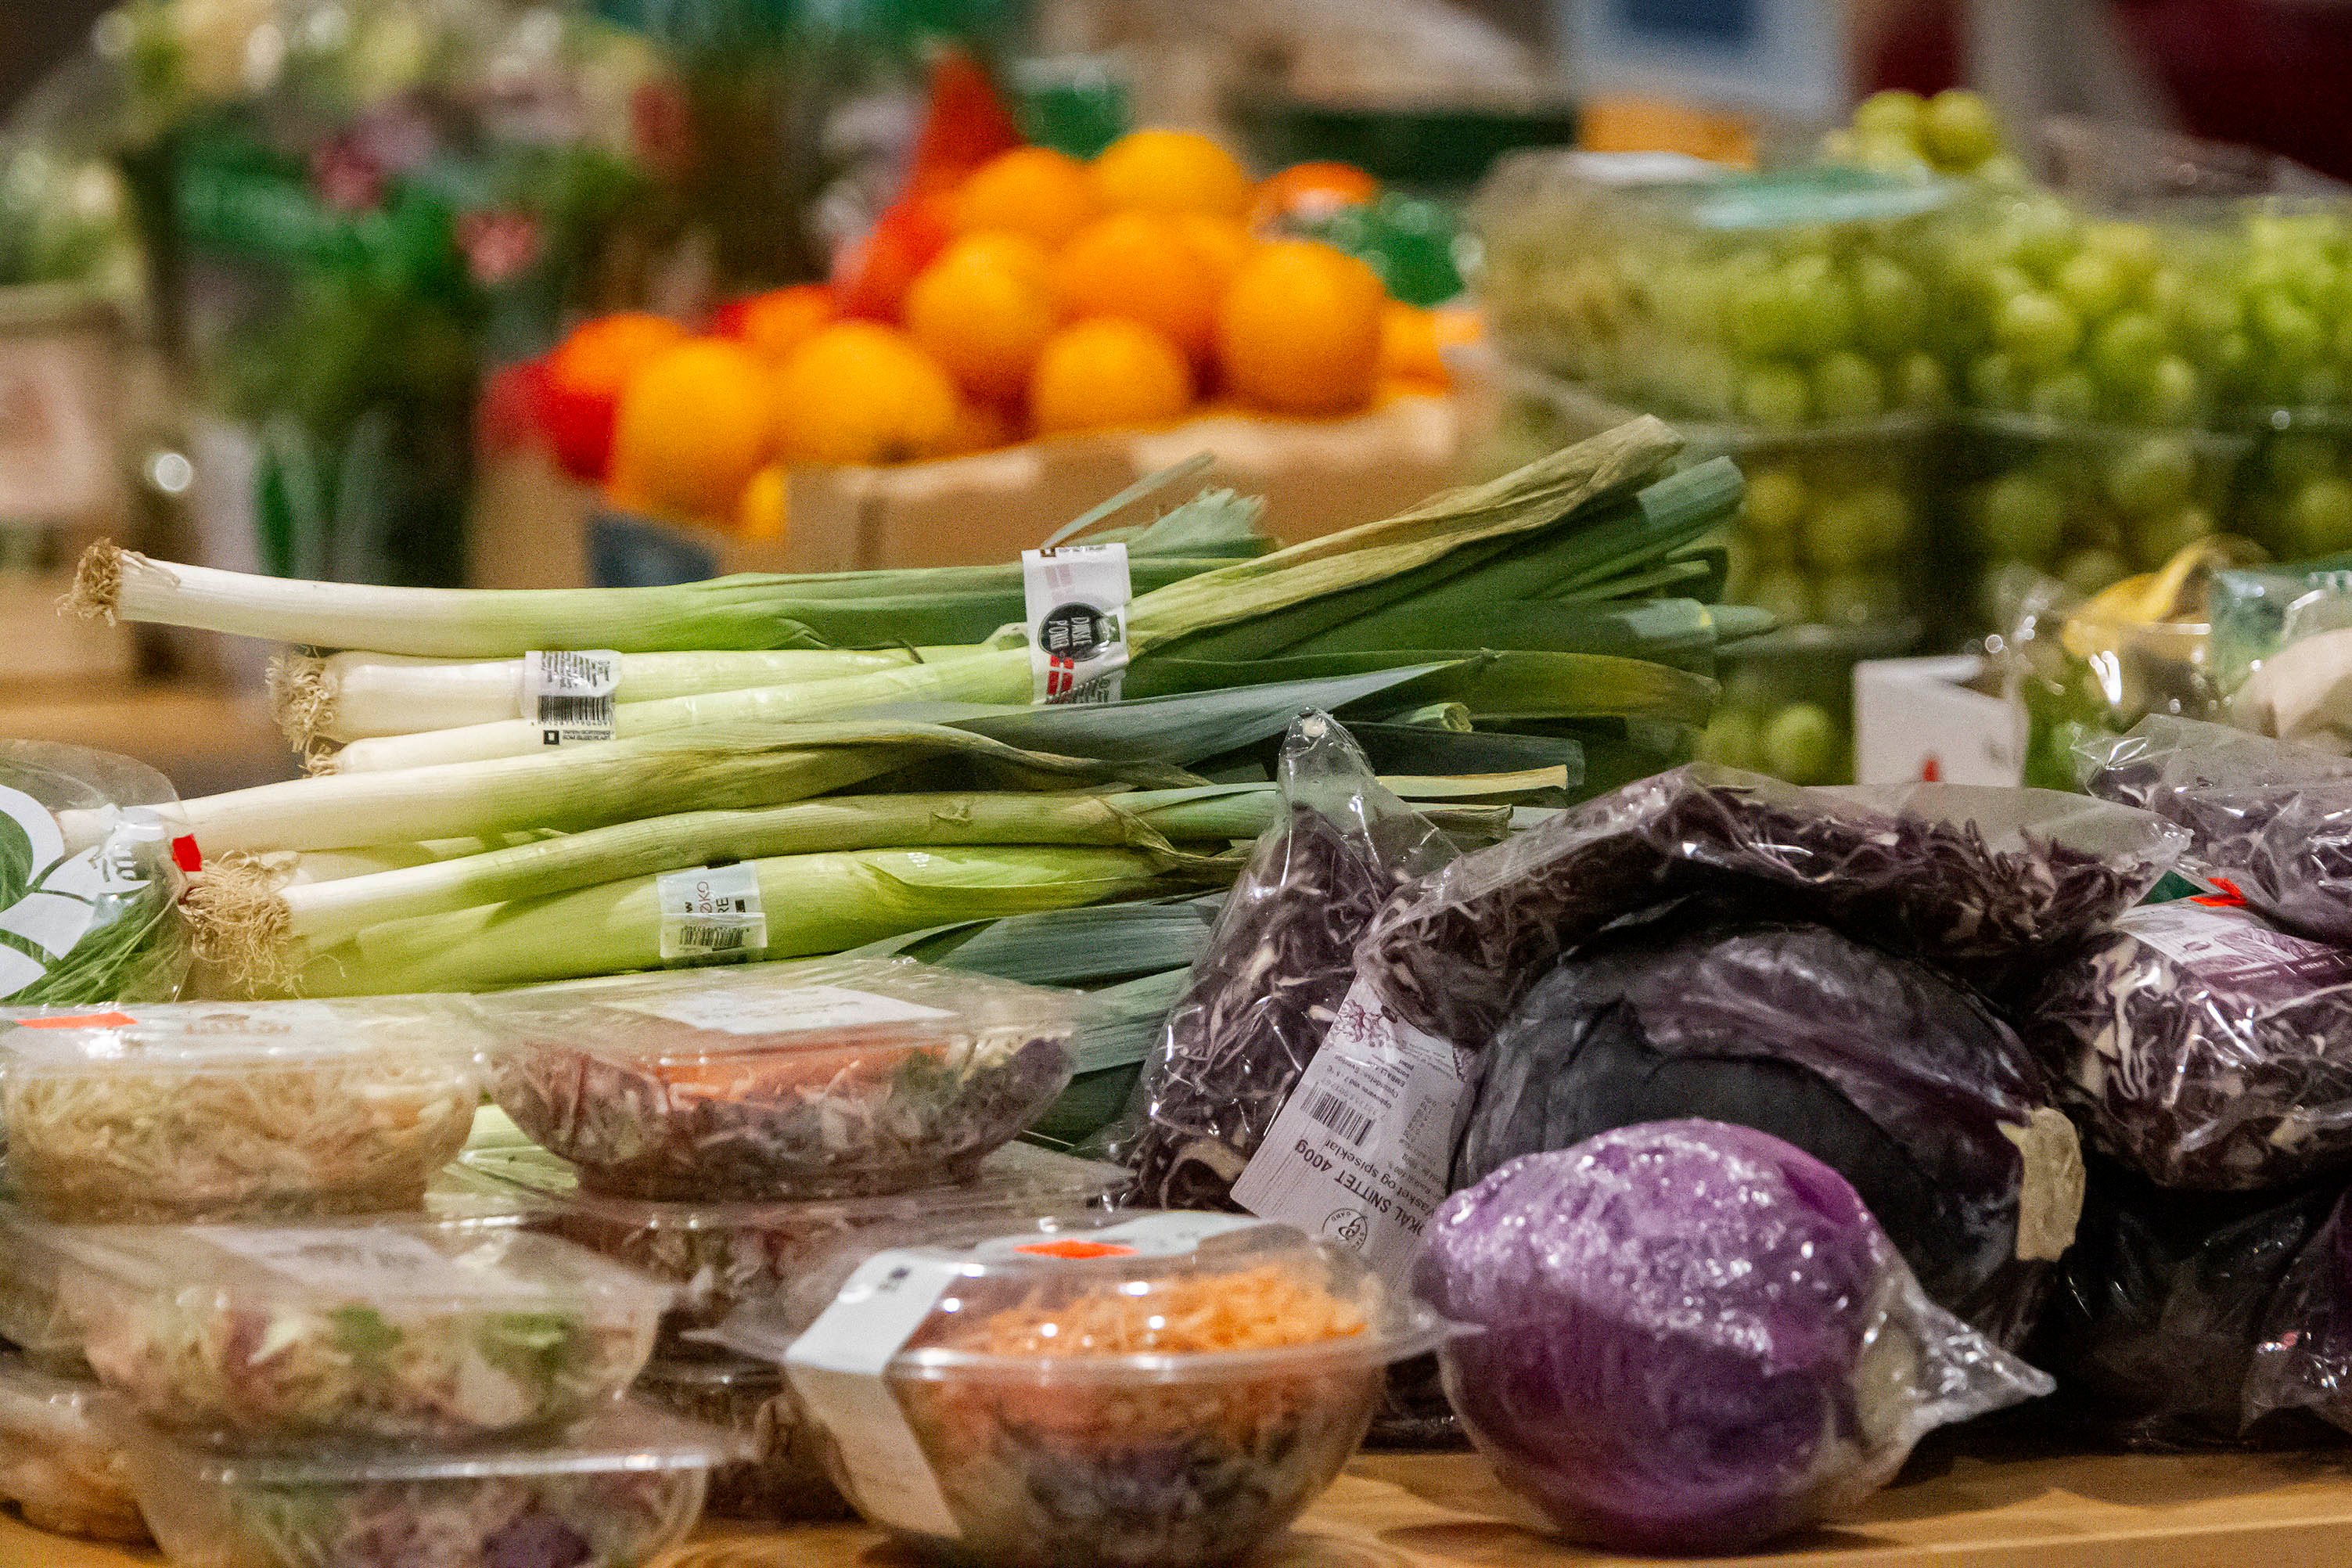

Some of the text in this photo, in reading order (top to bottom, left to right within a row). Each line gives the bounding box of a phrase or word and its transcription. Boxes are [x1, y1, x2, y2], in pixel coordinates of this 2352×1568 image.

[1294, 1138, 1332, 1173] 400g
[1325, 1138, 1379, 1178] spiseklar
[1335, 1169, 1393, 1214] SNITTET
[1381, 1173, 1397, 1190] og
